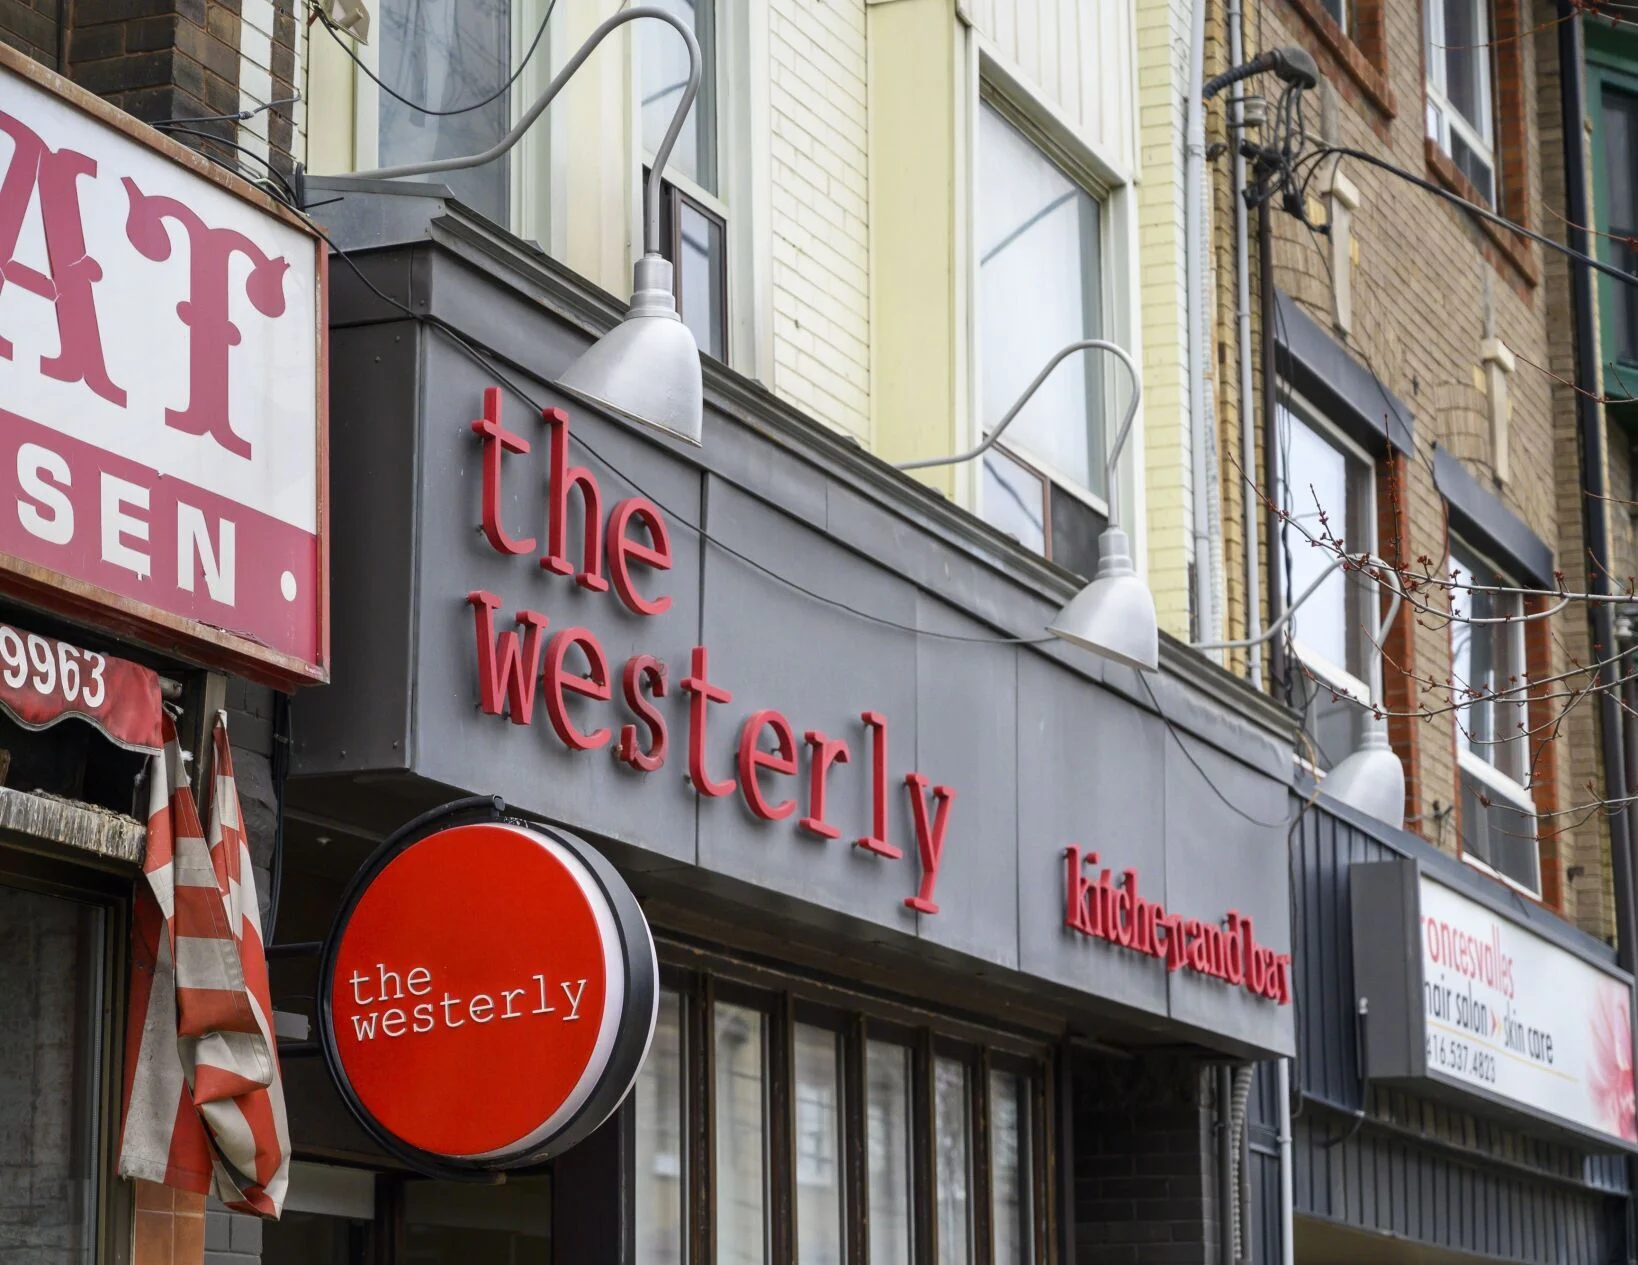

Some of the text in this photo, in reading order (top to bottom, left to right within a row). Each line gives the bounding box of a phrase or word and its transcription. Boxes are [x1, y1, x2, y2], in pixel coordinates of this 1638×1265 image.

[472, 387, 673, 616] the
[0, 626, 106, 708] 9963
[467, 590, 956, 914] westerly
[1065, 843, 1292, 1006] kitchen and bar
[349, 963, 432, 1005] the
[351, 974, 588, 1042] westerly
[1455, 980, 1488, 1037] salon
[1504, 999, 1526, 1054] skin
[1527, 1026, 1554, 1065] care
